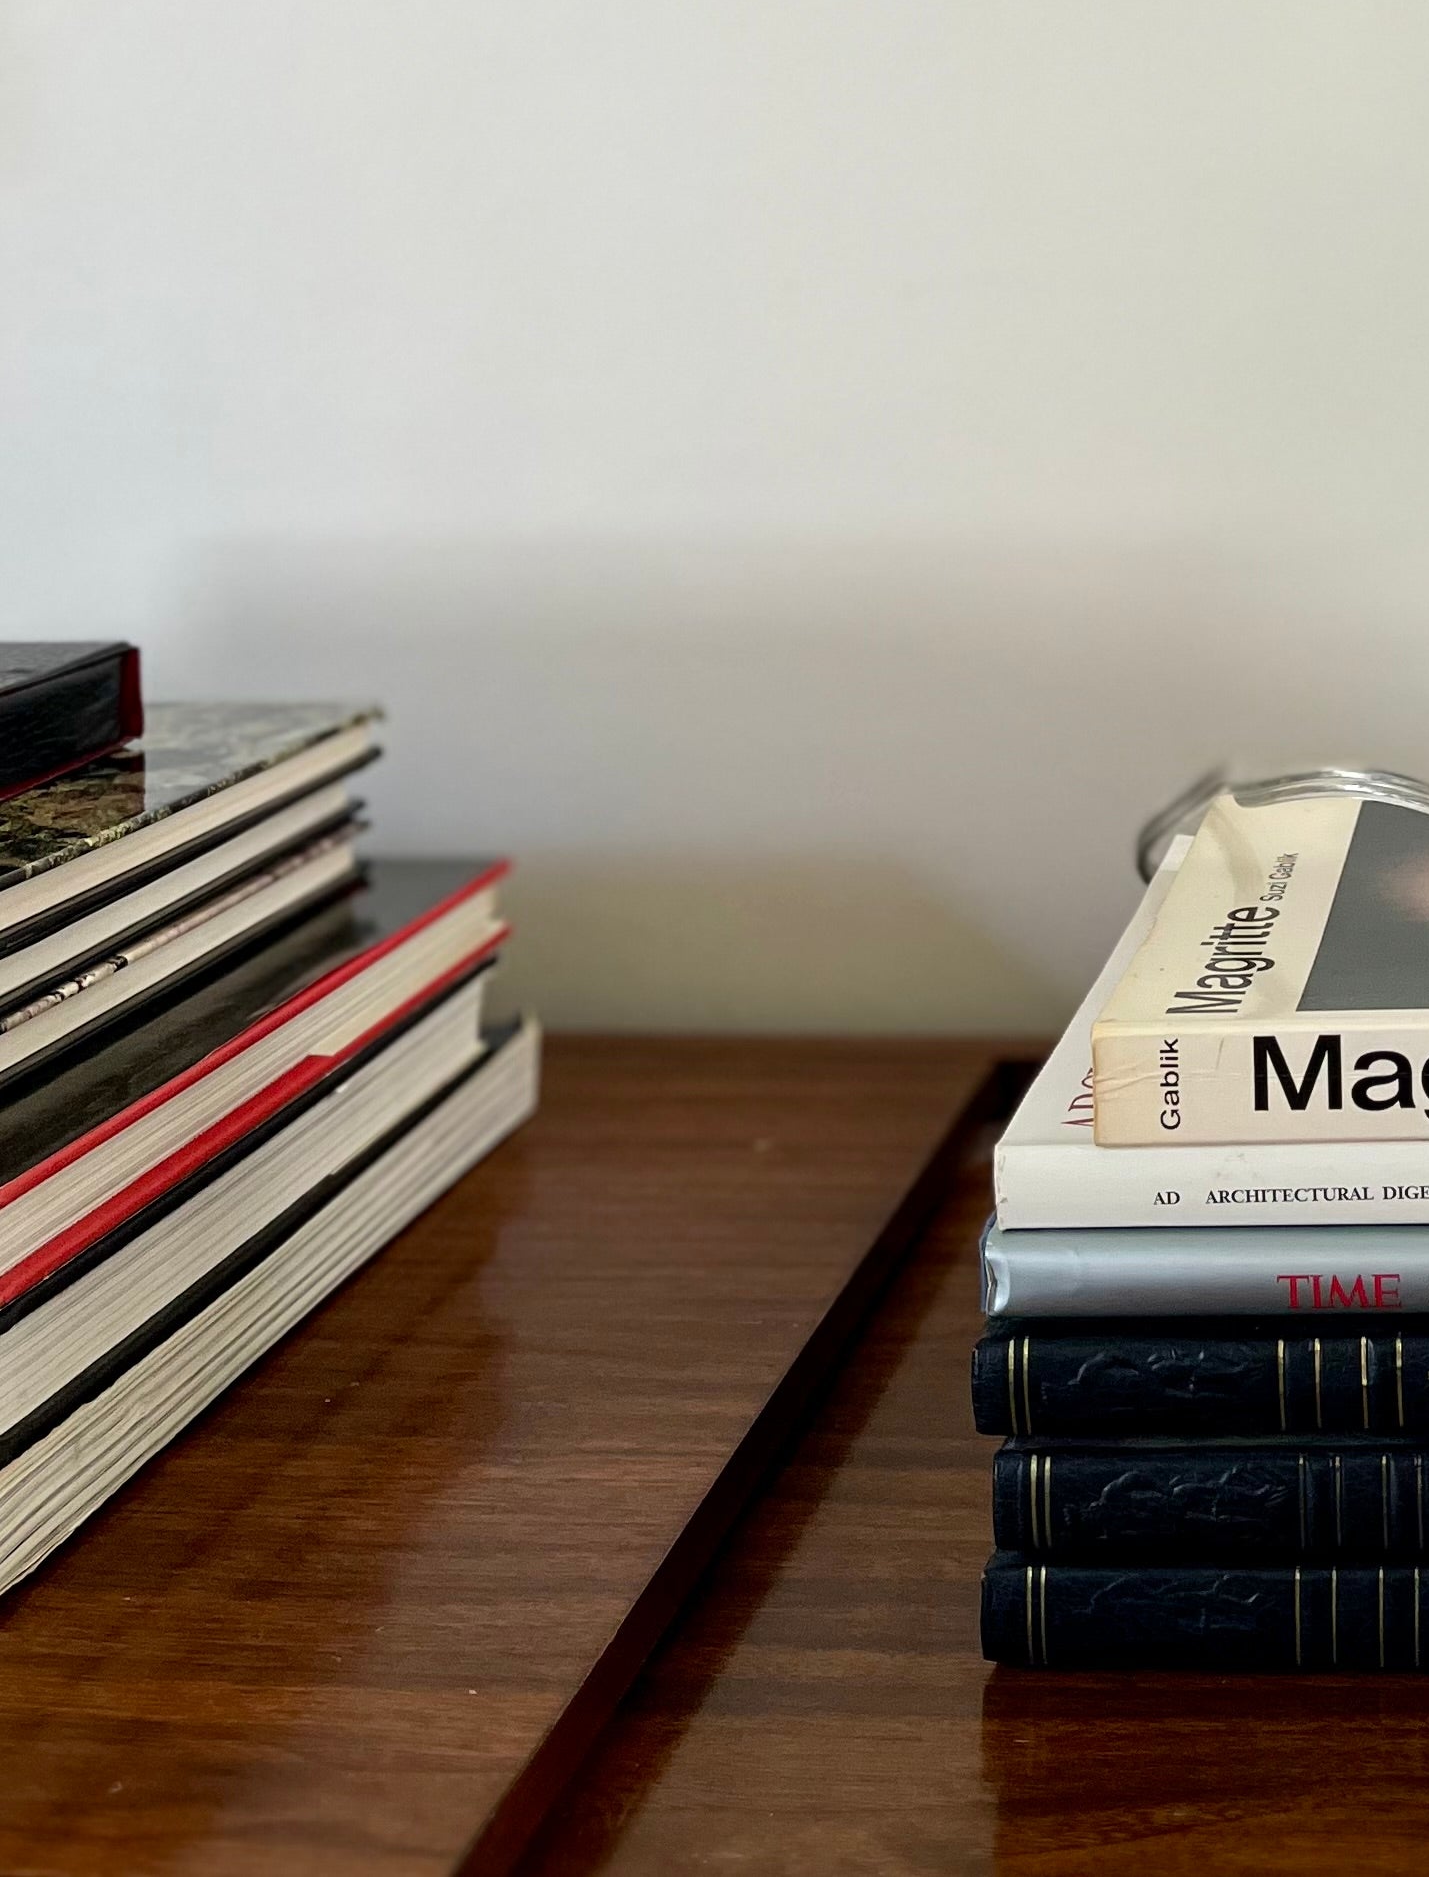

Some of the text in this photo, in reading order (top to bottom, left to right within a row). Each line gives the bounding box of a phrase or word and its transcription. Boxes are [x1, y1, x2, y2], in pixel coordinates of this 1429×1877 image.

[1165, 906, 1280, 1014] Magritte
[1260, 881, 1287, 902] Suzi
[1160, 1038, 1181, 1130] Gablik
[1153, 1190, 1181, 1206] AD
[1205, 1186, 1375, 1205] ARCHITECTURAL
[1278, 1274, 1401, 1310] TIME
